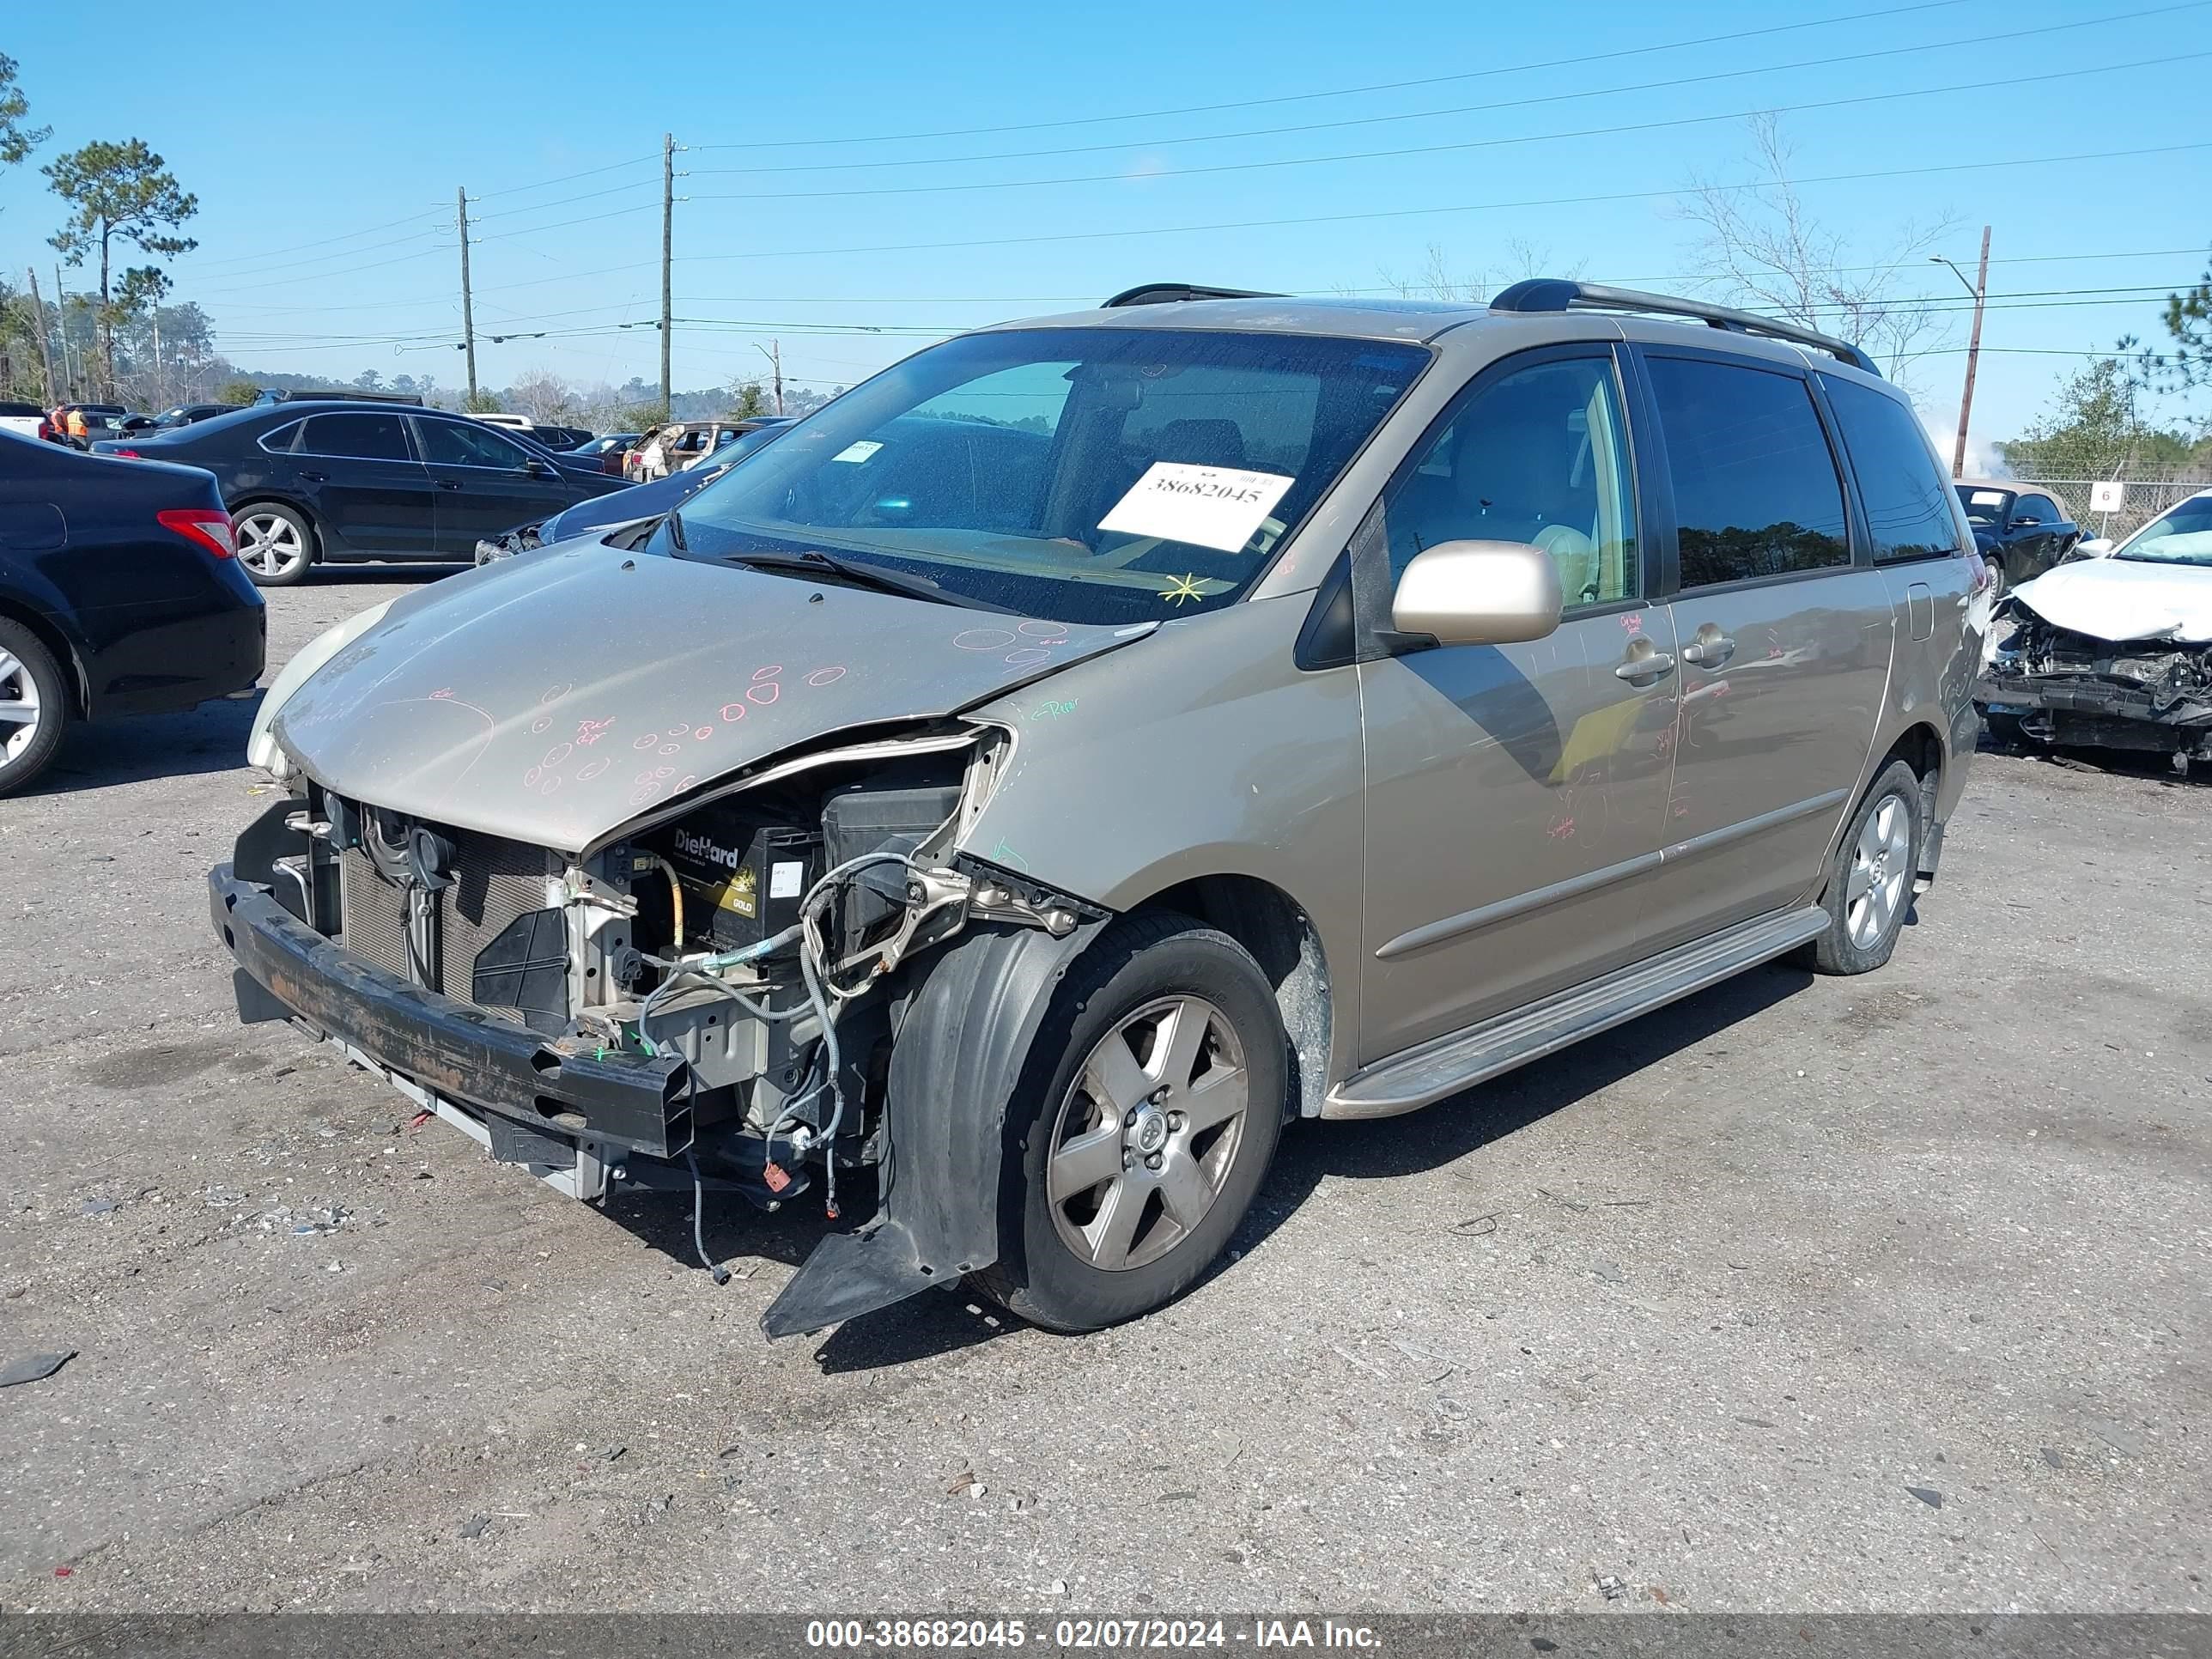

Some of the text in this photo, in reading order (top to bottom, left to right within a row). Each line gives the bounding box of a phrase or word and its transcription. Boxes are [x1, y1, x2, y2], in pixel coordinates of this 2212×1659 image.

[1148, 477, 1262, 503] 38682045
[2102, 490, 2111, 501] 6
[674, 828, 738, 869] DieHard
[733, 898, 752, 912] GOLD
